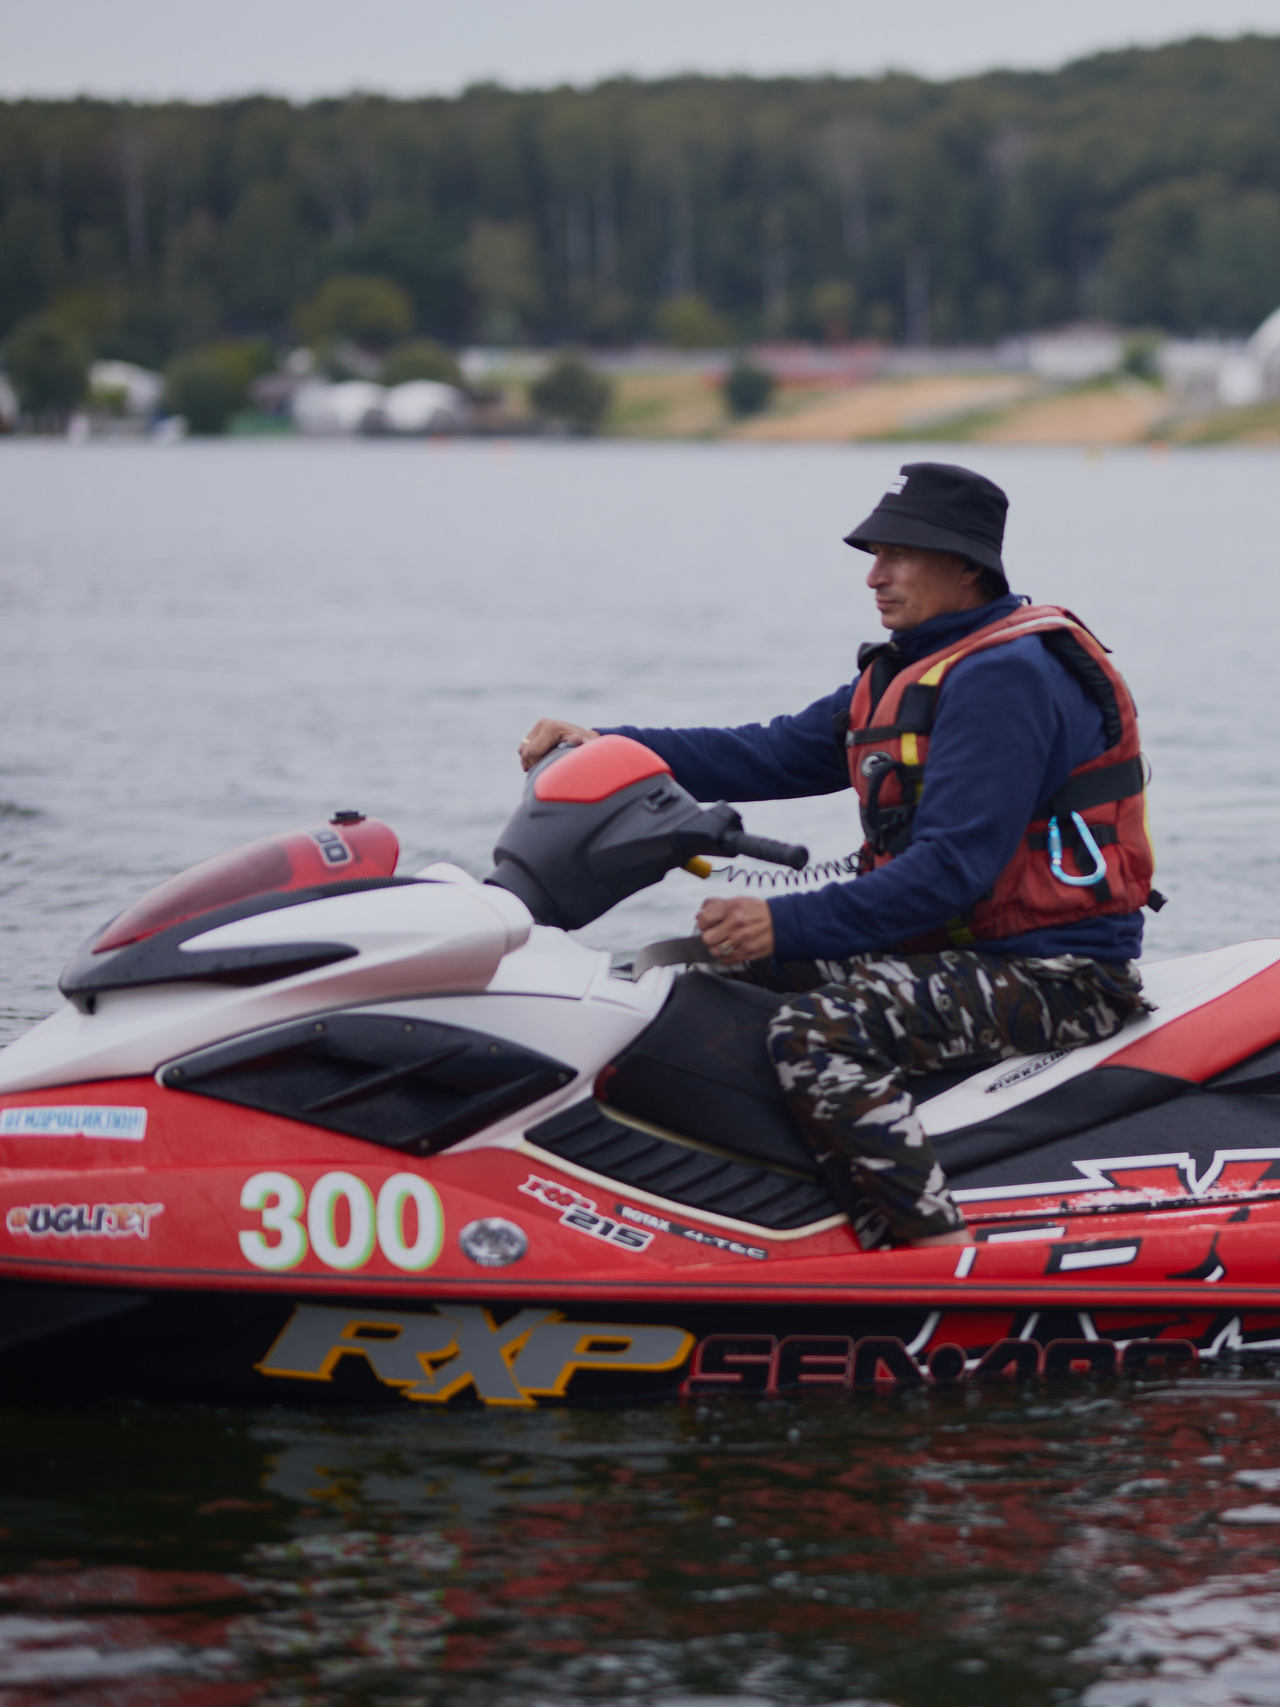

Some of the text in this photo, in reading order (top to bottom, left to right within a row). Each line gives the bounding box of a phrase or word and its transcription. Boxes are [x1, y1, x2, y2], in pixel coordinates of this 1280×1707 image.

[239, 1171, 444, 1270] 300
[560, 1206, 653, 1251] 215
[620, 1205, 672, 1232] ROTAX
[253, 1302, 697, 1408] RXP
